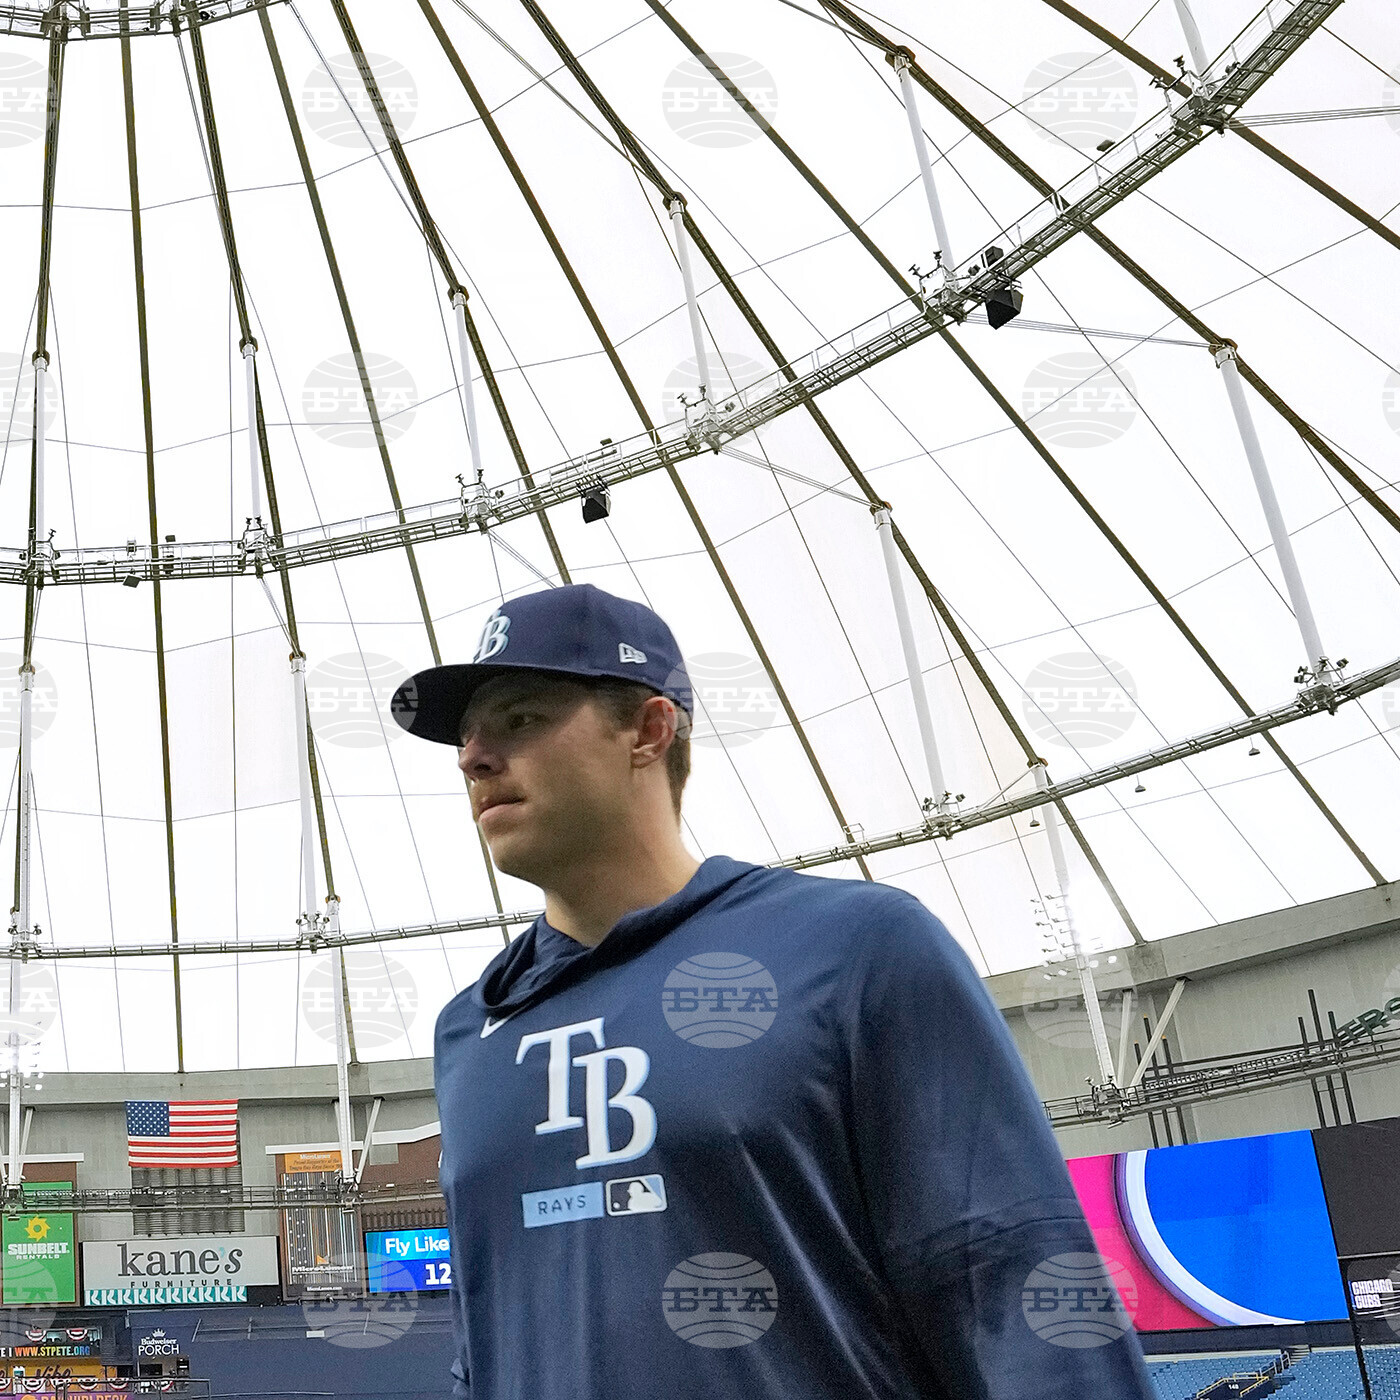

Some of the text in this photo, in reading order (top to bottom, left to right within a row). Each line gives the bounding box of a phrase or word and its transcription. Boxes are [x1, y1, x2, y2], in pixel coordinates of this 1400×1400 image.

[515, 1017, 658, 1170] TB
[537, 1194, 587, 1217] RAYS
[386, 1236, 450, 1256] Fly Like
[116, 1242, 243, 1277] kane's
[130, 1278, 233, 1288] FURNITURE
[1352, 1279, 1394, 1295] CHICAGO
[1354, 1294, 1382, 1309] CUBS
[14, 1346, 90, 1357] WWW.STPETE.ORG
[138, 1344, 180, 1356] PORCH
